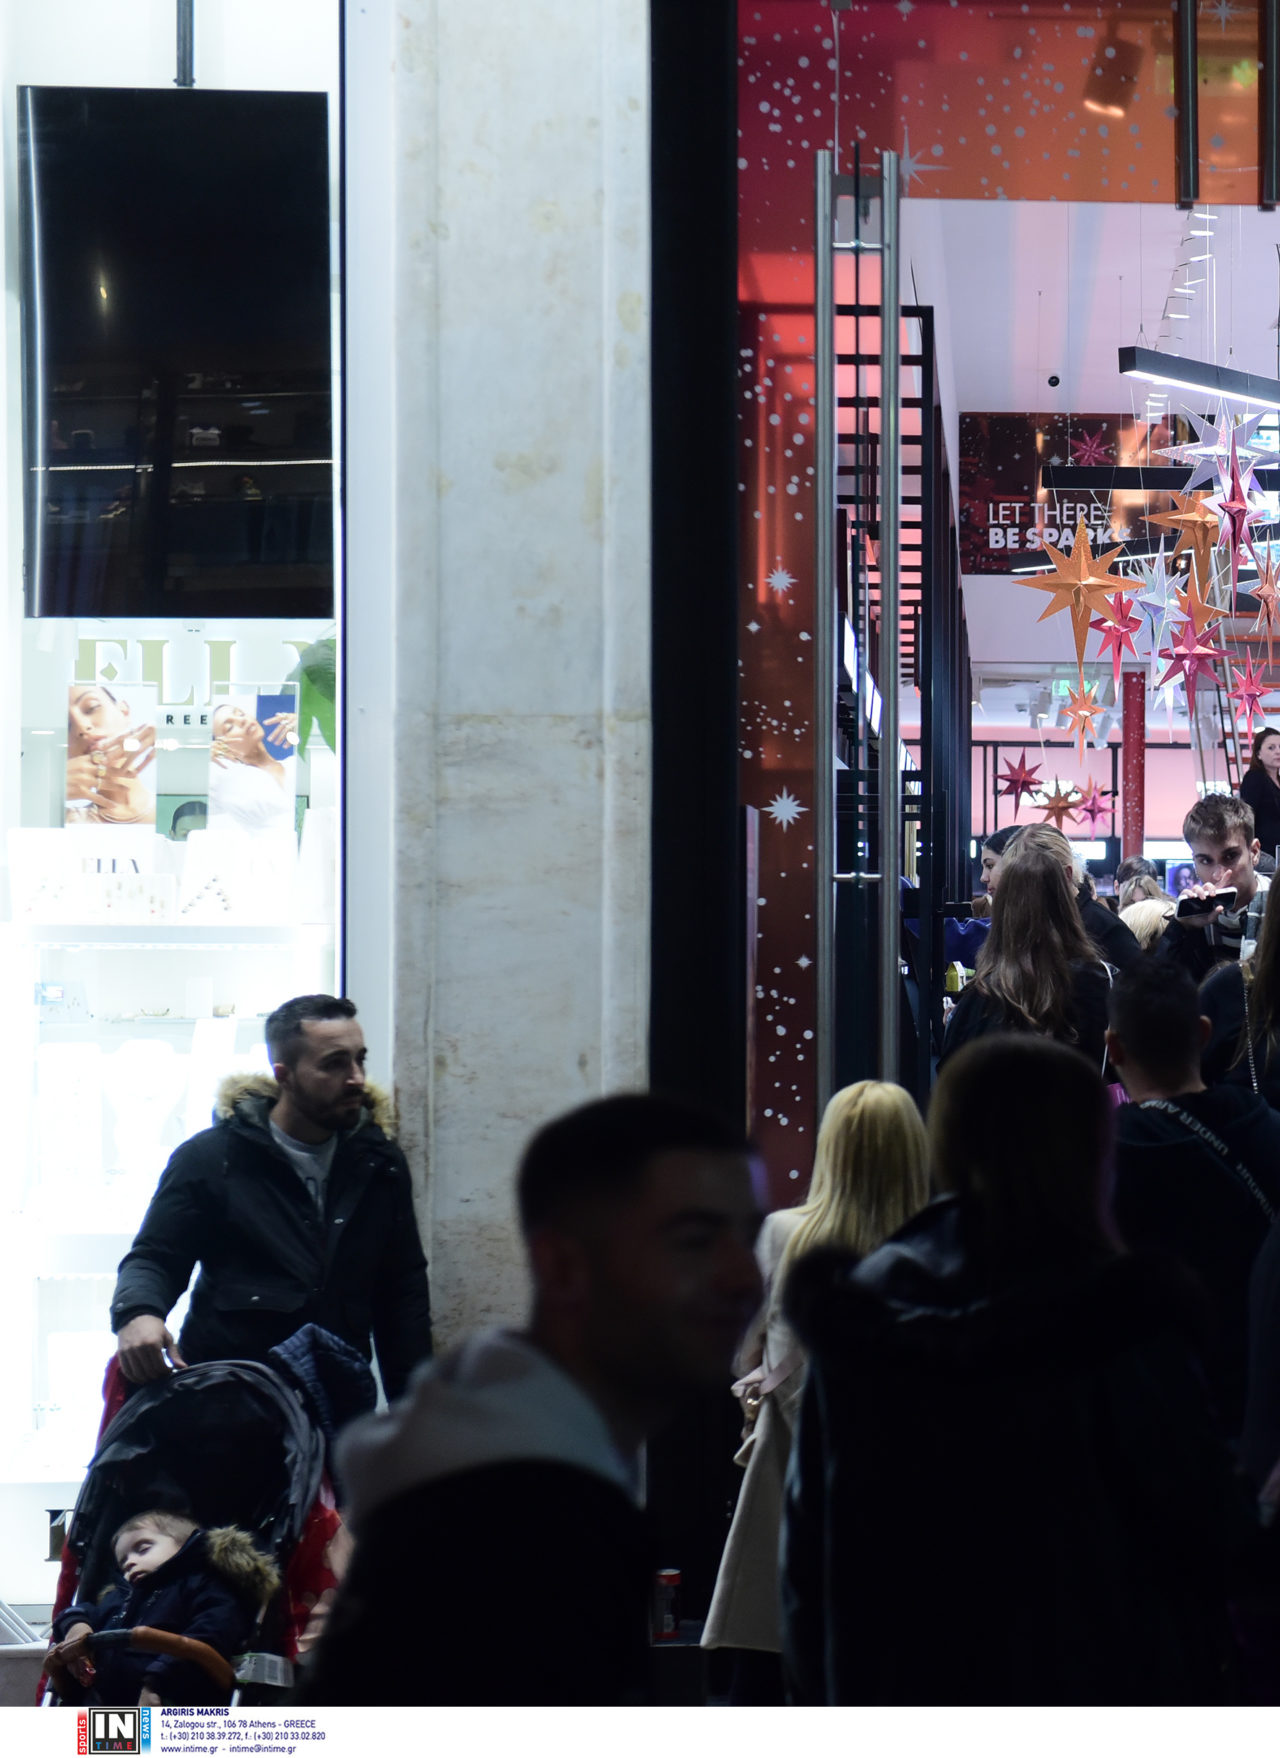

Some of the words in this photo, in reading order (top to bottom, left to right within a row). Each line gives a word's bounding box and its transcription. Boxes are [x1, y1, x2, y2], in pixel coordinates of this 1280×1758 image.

[988, 502, 1024, 525] LET
[1030, 502, 1106, 525] THERE
[988, 527, 1020, 549] BE
[74, 638, 312, 706] ELL
